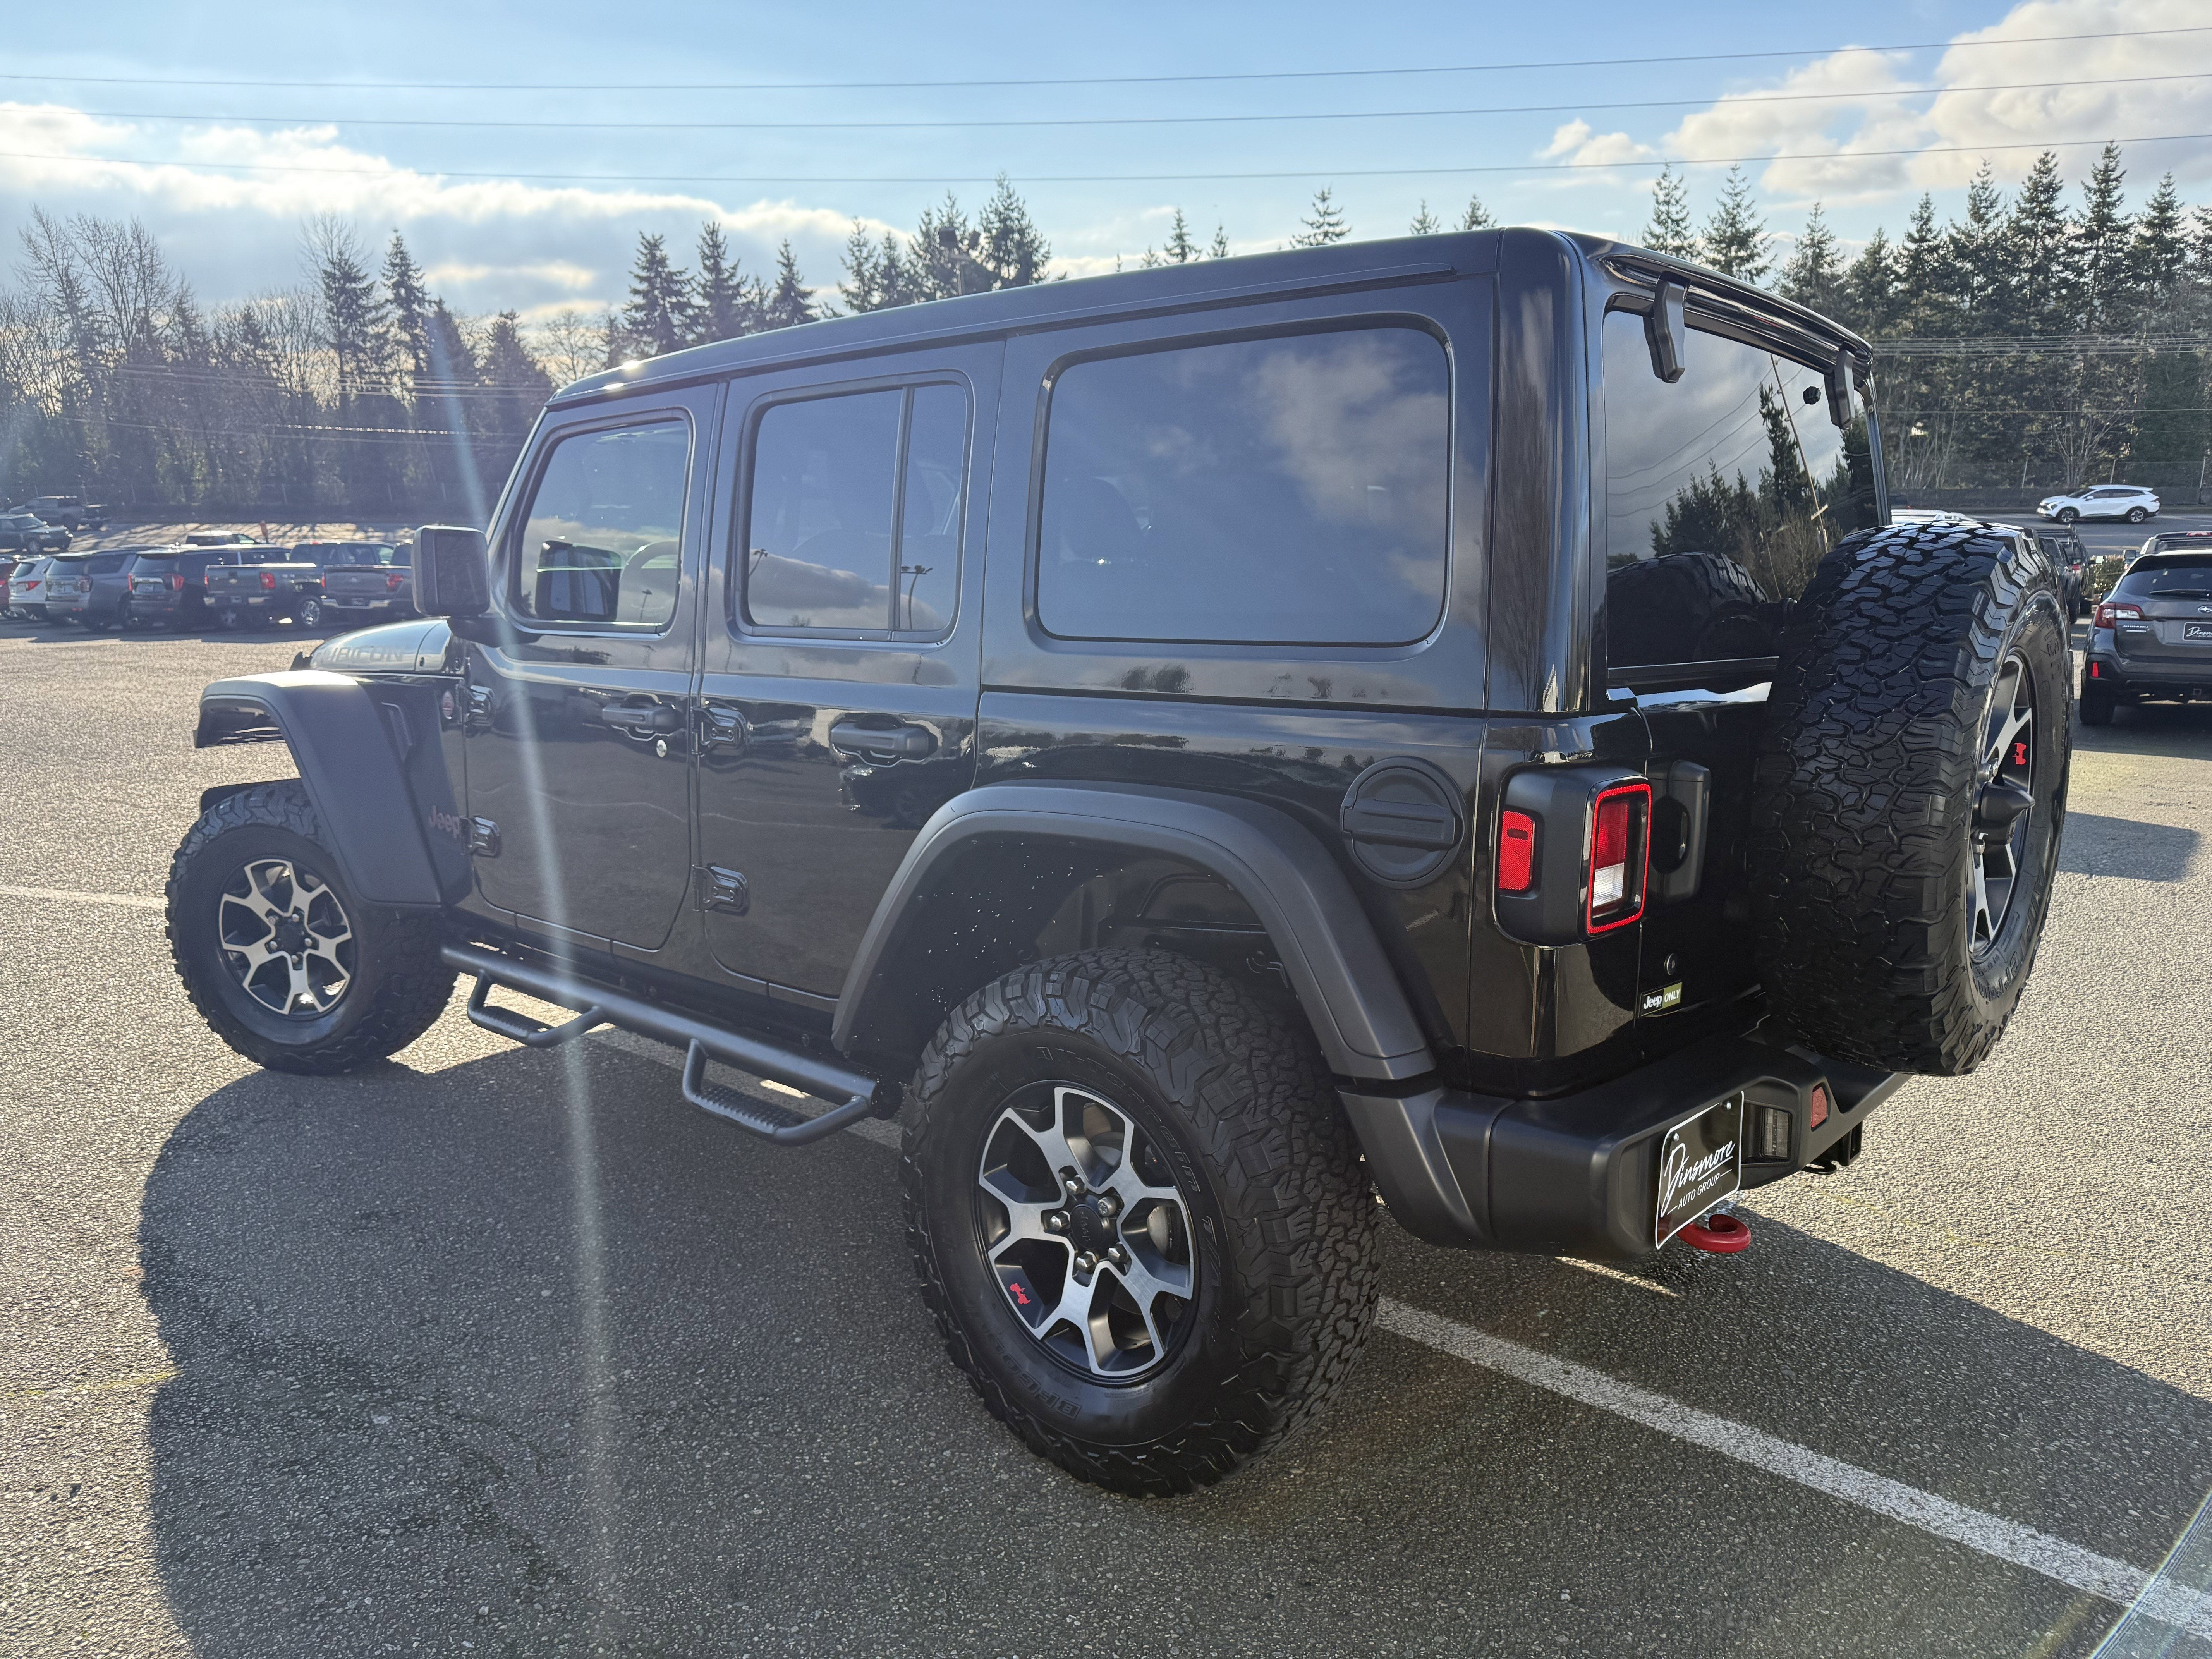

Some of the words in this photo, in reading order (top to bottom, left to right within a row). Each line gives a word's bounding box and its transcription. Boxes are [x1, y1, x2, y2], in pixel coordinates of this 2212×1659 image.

[428, 804, 459, 838] Jeep
[1643, 995, 1662, 1009] Jeep
[1664, 988, 1681, 1002] ONLY
[1660, 1140, 1736, 1218] Dinsmore
[1678, 1189, 1696, 1210] AUTO
[1697, 1173, 1720, 1196] GROUP
